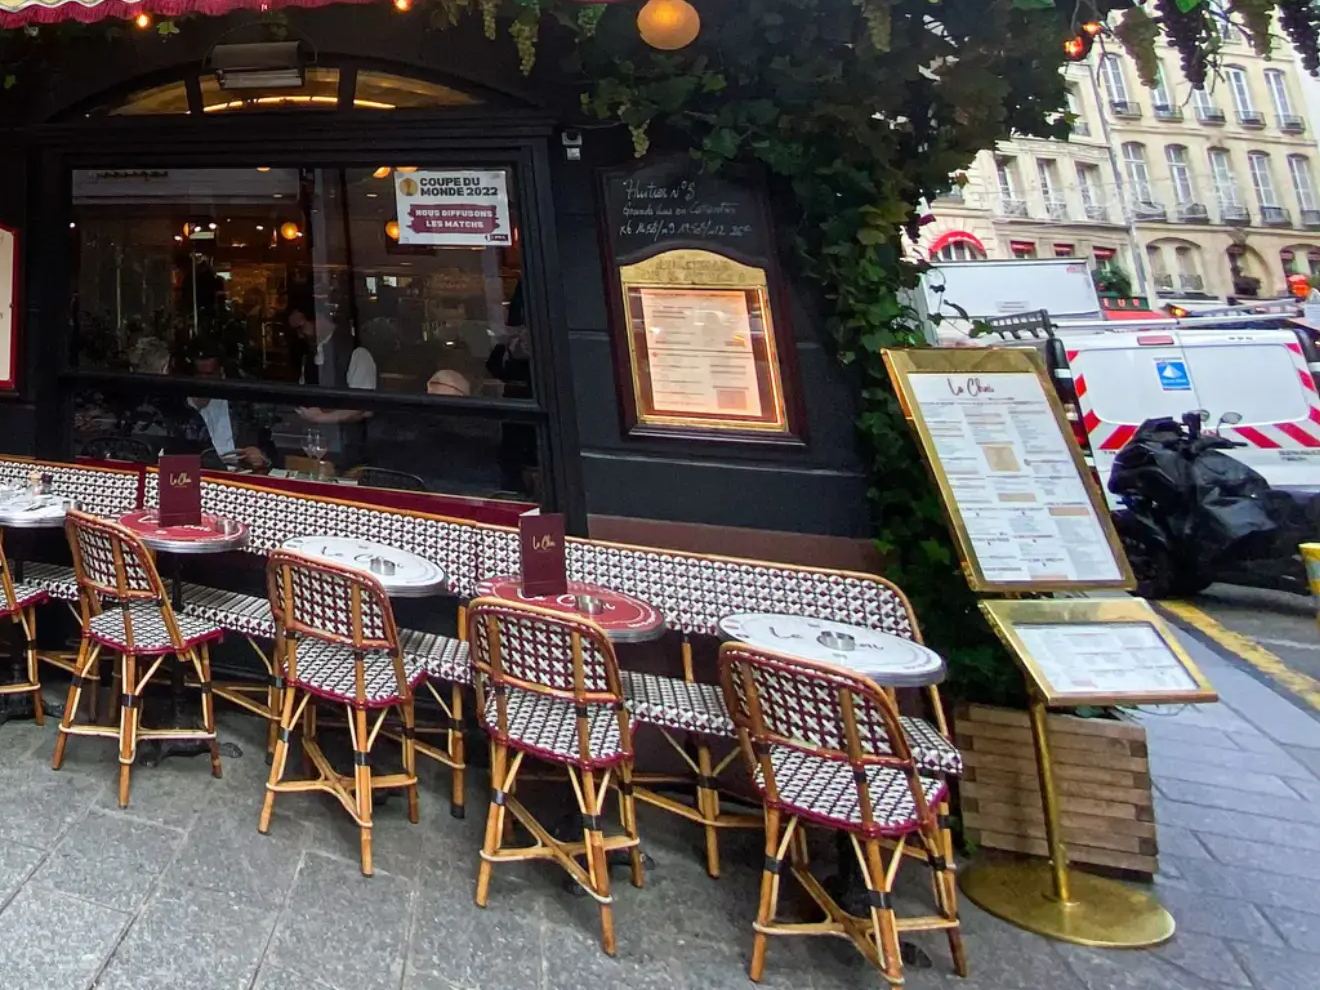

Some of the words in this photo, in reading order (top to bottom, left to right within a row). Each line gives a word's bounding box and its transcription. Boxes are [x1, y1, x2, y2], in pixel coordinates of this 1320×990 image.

[419, 177, 461, 187] COUPE
[463, 177, 481, 186] DU
[420, 187, 464, 197] MONDE
[466, 187, 498, 196] 2022
[415, 209, 440, 217] NOUS
[441, 209, 493, 218] DIFFUSONS
[426, 220, 443, 228] LES
[444, 220, 484, 229] MATCHS
